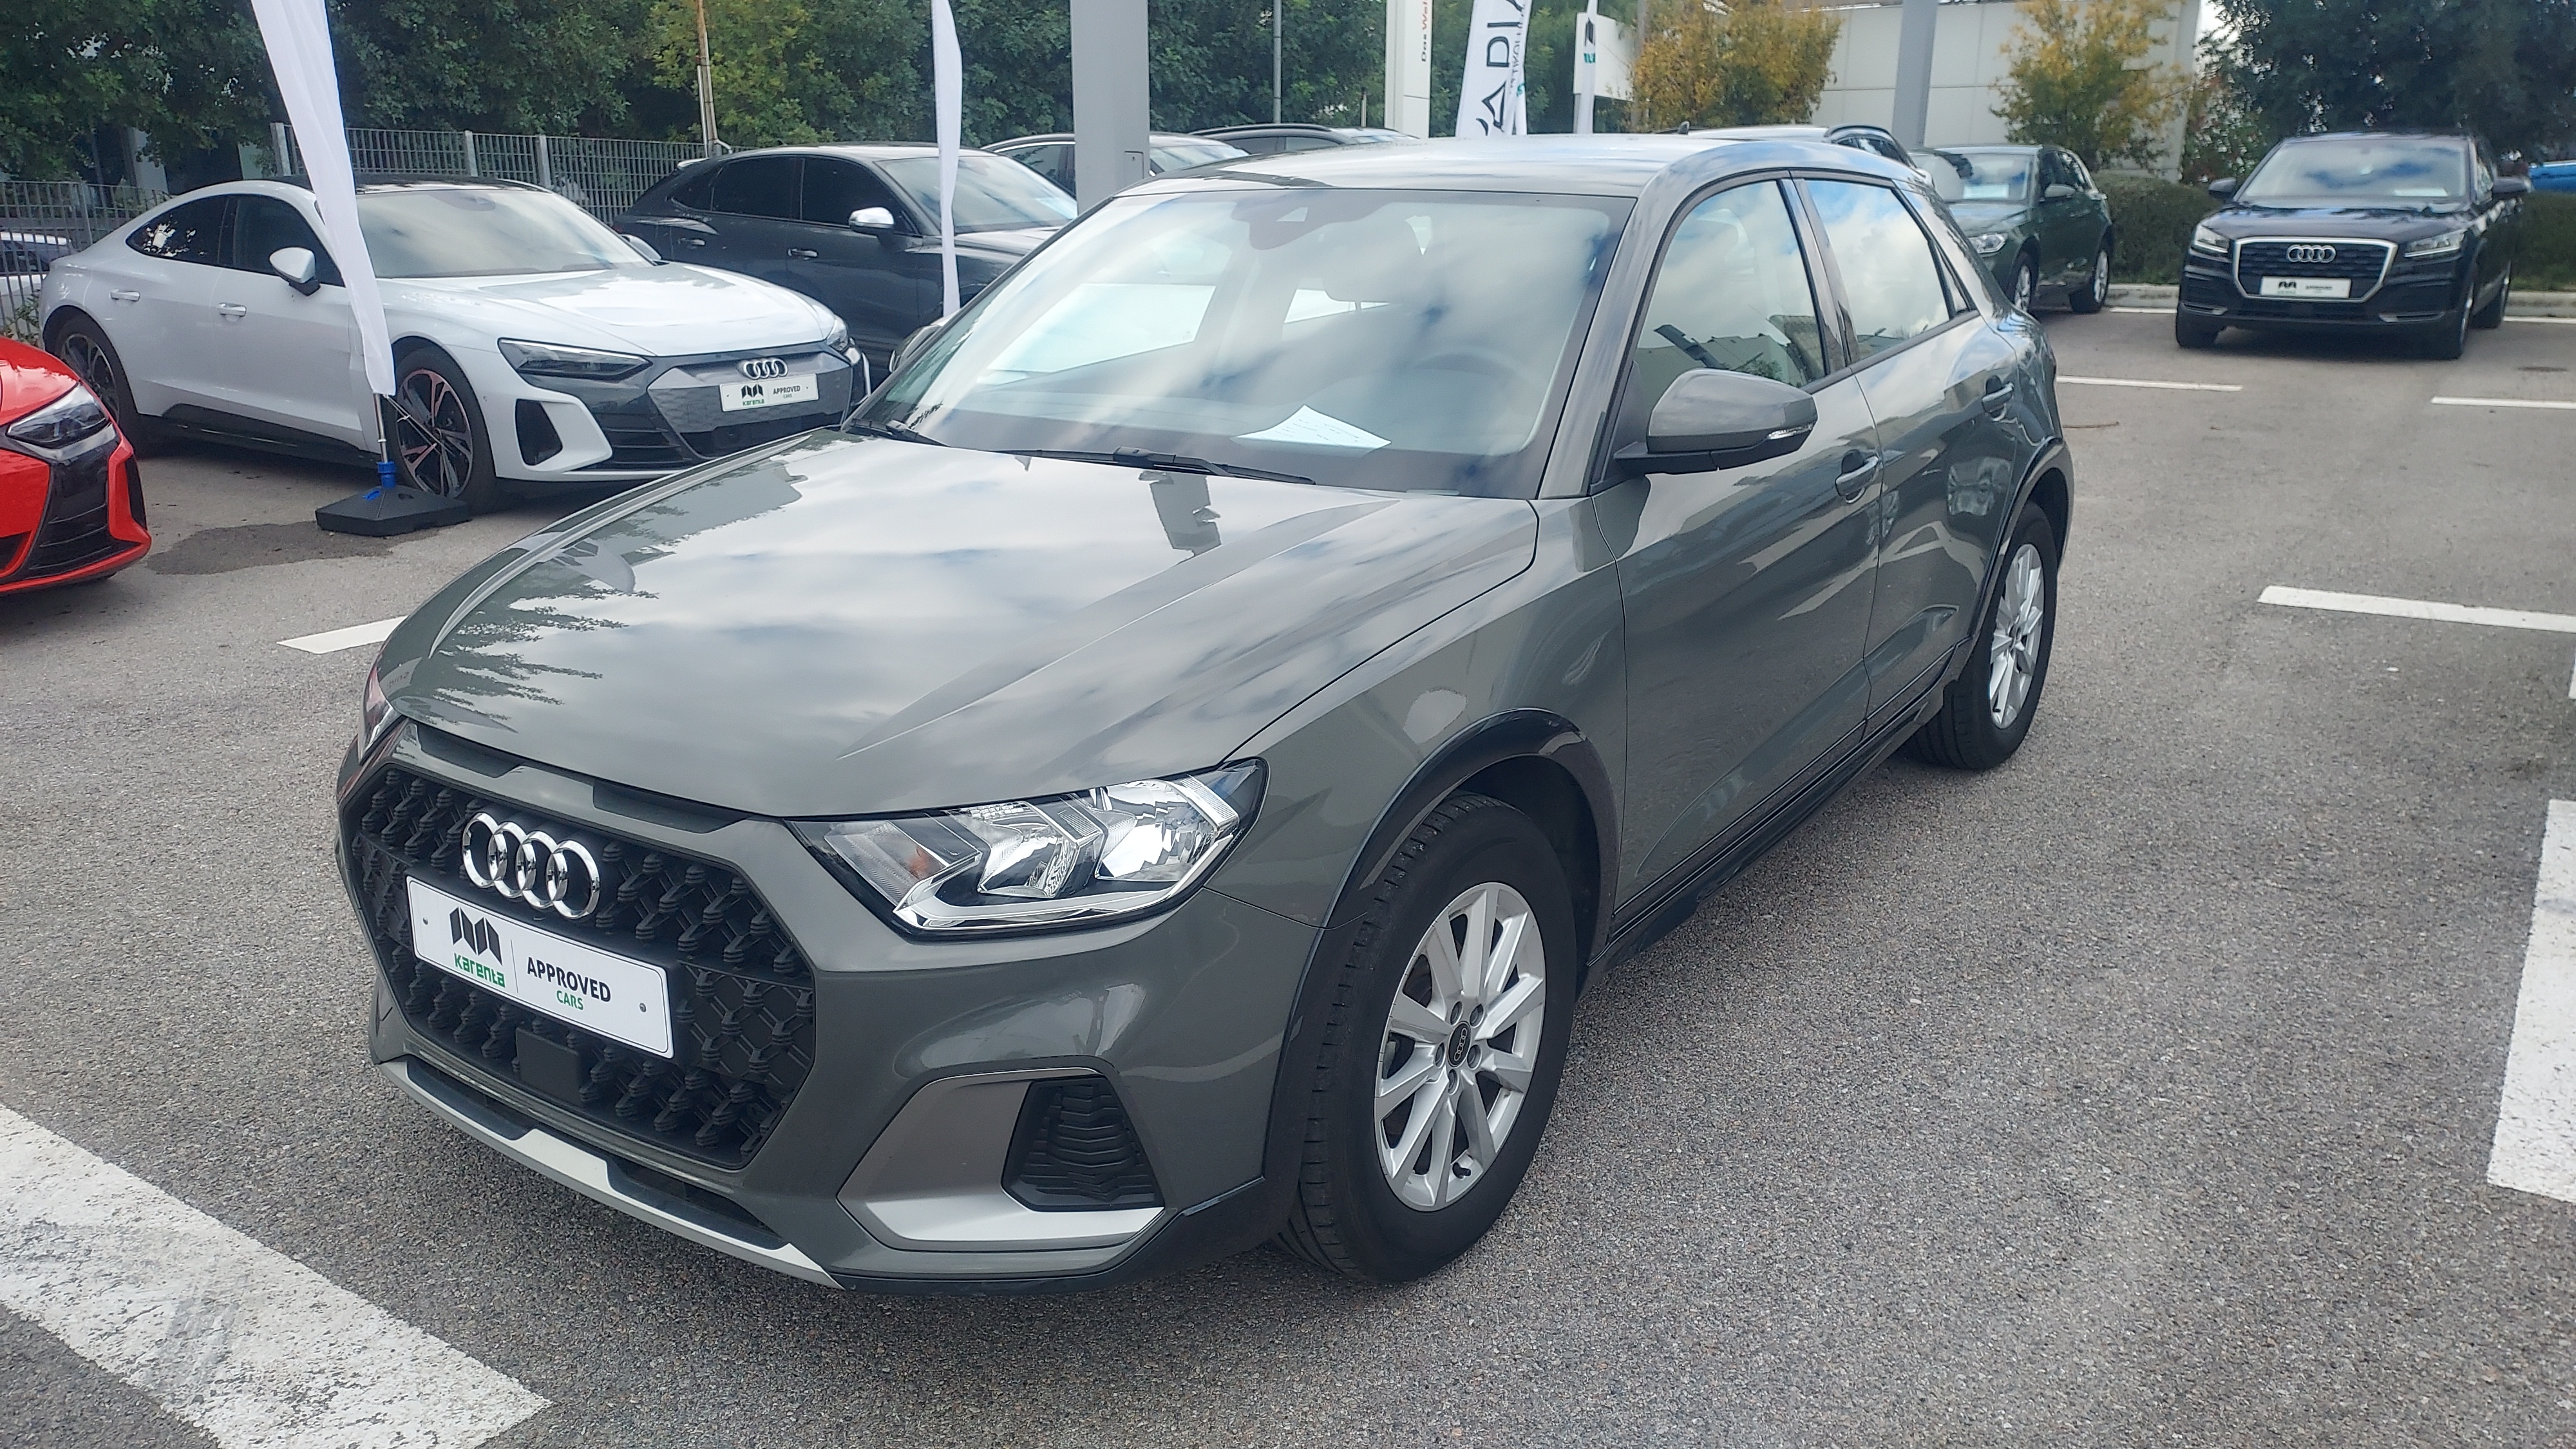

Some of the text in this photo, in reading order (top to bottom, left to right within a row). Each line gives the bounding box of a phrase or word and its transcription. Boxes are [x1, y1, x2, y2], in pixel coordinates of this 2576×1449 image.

[773, 386, 800, 395] APPROVED
[527, 956, 611, 1002] APPROVED
[556, 990, 583, 1010] CARS
